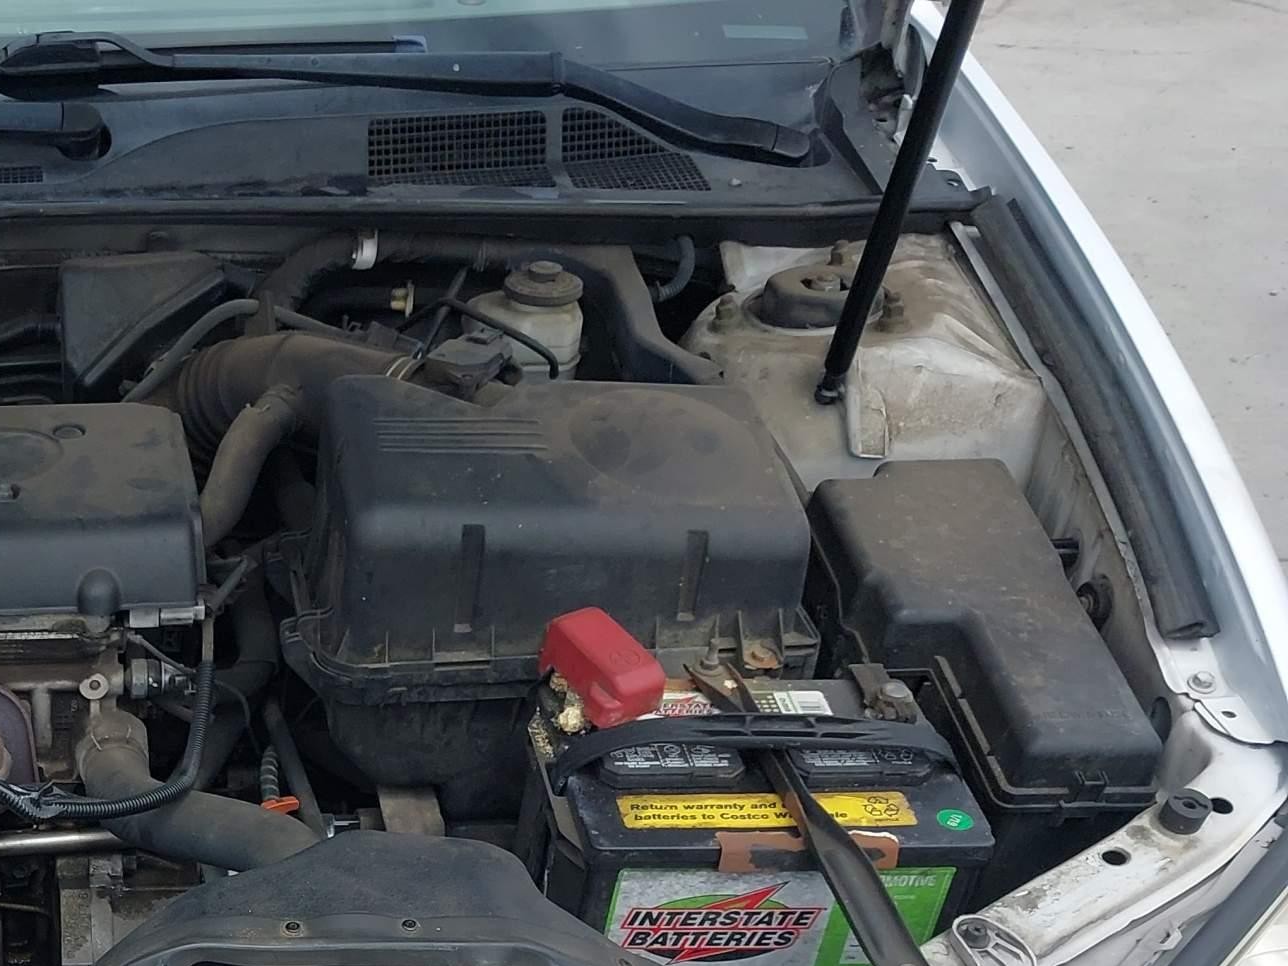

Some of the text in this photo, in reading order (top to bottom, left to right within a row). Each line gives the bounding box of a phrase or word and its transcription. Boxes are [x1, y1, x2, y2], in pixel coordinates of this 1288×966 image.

[630, 801, 777, 811] Return warranty and
[633, 812, 698, 821] batteries
[701, 812, 716, 820] to
[719, 812, 770, 820] Costco
[627, 910, 815, 927] INTERSTATE
[627, 930, 796, 947] BATTERIES
